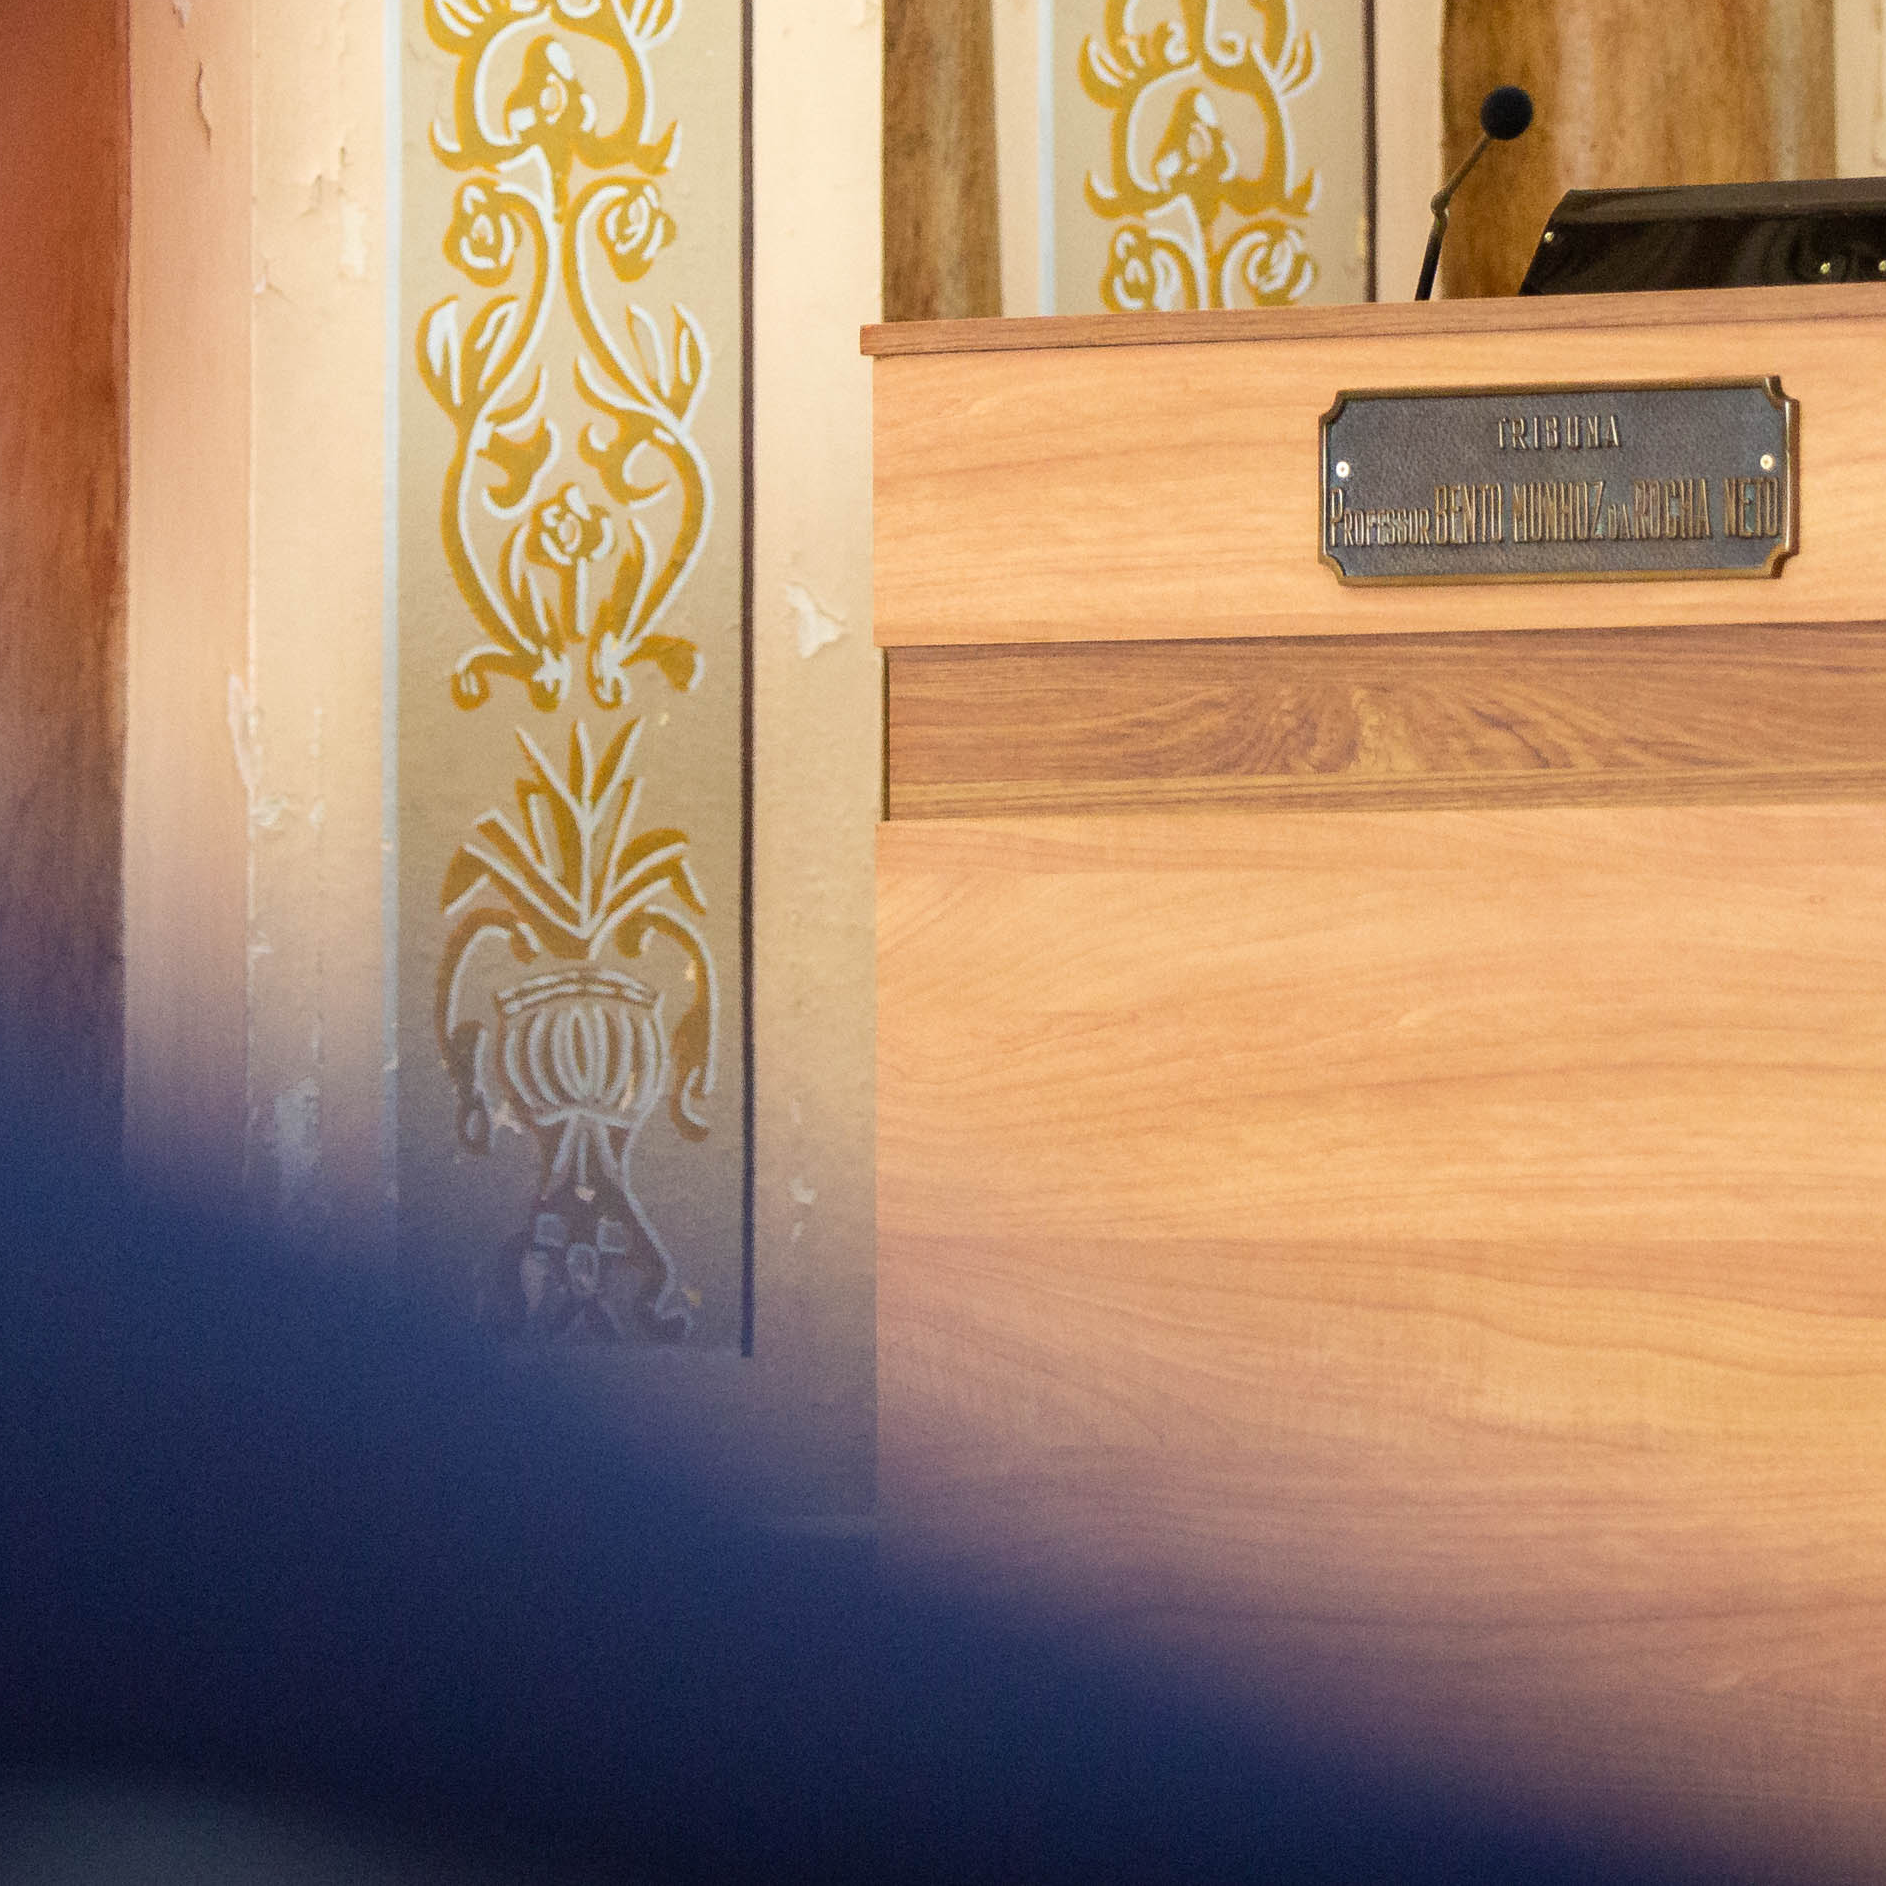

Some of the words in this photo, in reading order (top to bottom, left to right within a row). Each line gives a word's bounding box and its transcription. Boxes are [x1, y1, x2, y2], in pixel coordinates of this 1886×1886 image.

[1497, 414, 1620, 450] TRIBUNA
[1329, 488, 1431, 547] PROFESSOR
[1434, 483, 1503, 545] BENTO
[1512, 479, 1605, 542] MUNHOZ
[1632, 477, 1713, 539] ROCHA
[1722, 476, 1780, 537] NETO
